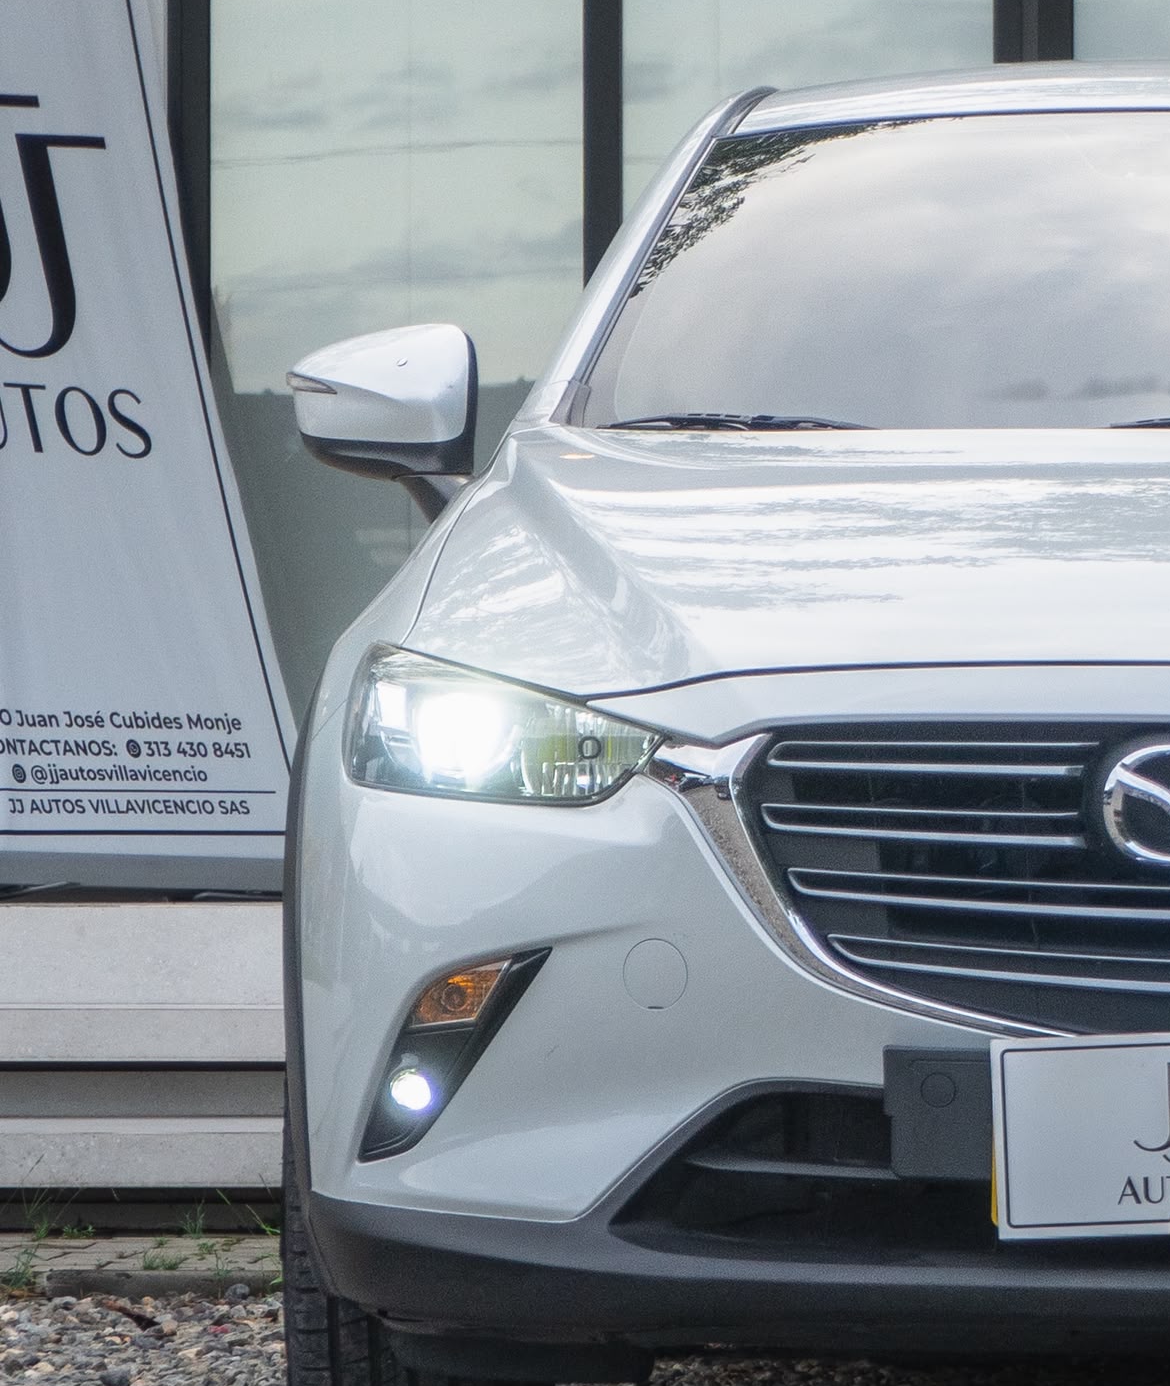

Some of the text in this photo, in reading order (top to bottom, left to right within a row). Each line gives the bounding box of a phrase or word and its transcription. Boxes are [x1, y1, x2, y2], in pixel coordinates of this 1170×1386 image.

[15, 710, 60, 728] Juan
[63, 710, 105, 728] José
[109, 711, 183, 730] Cubides
[186, 713, 242, 735] Monje
[143, 740, 172, 757] 313
[176, 741, 208, 758] 430
[212, 742, 251, 759] 8451
[30, 763, 208, 785] @jjautosvillavicencio
[8, 798, 251, 815] JJ AUTOS VILLAVICENCIO SAS
